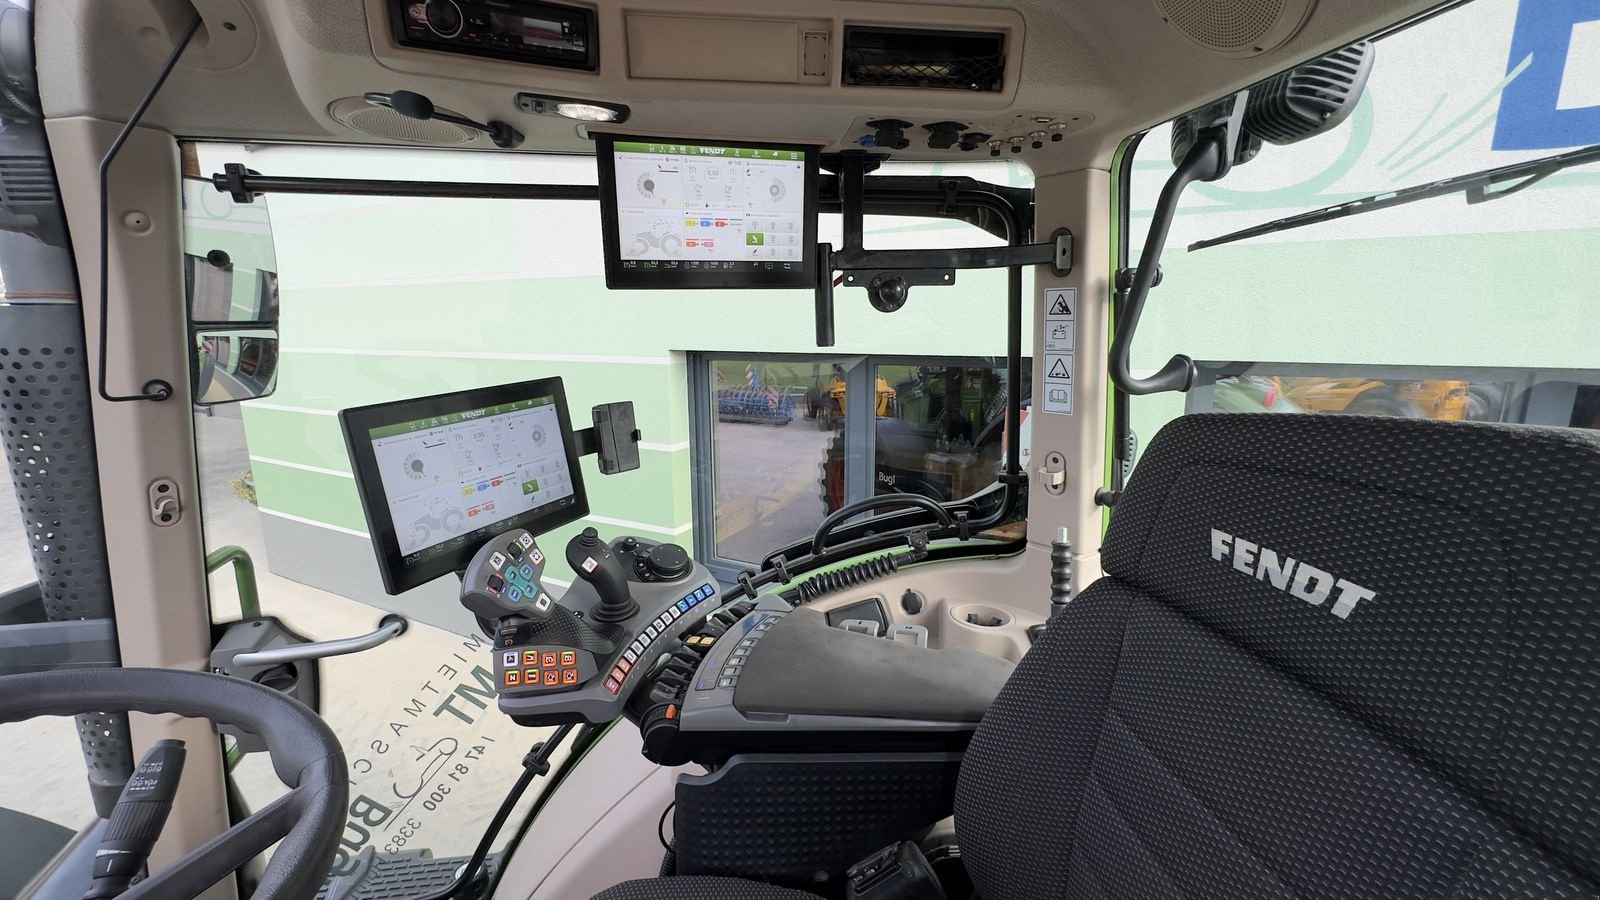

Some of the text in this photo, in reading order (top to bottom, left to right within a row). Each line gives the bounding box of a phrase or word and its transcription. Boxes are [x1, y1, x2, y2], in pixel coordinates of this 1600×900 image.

[699, 146, 726, 155] FENDT
[461, 409, 486, 419] FENDT
[878, 471, 896, 485] Bugl
[1211, 528, 1376, 619] FENDT
